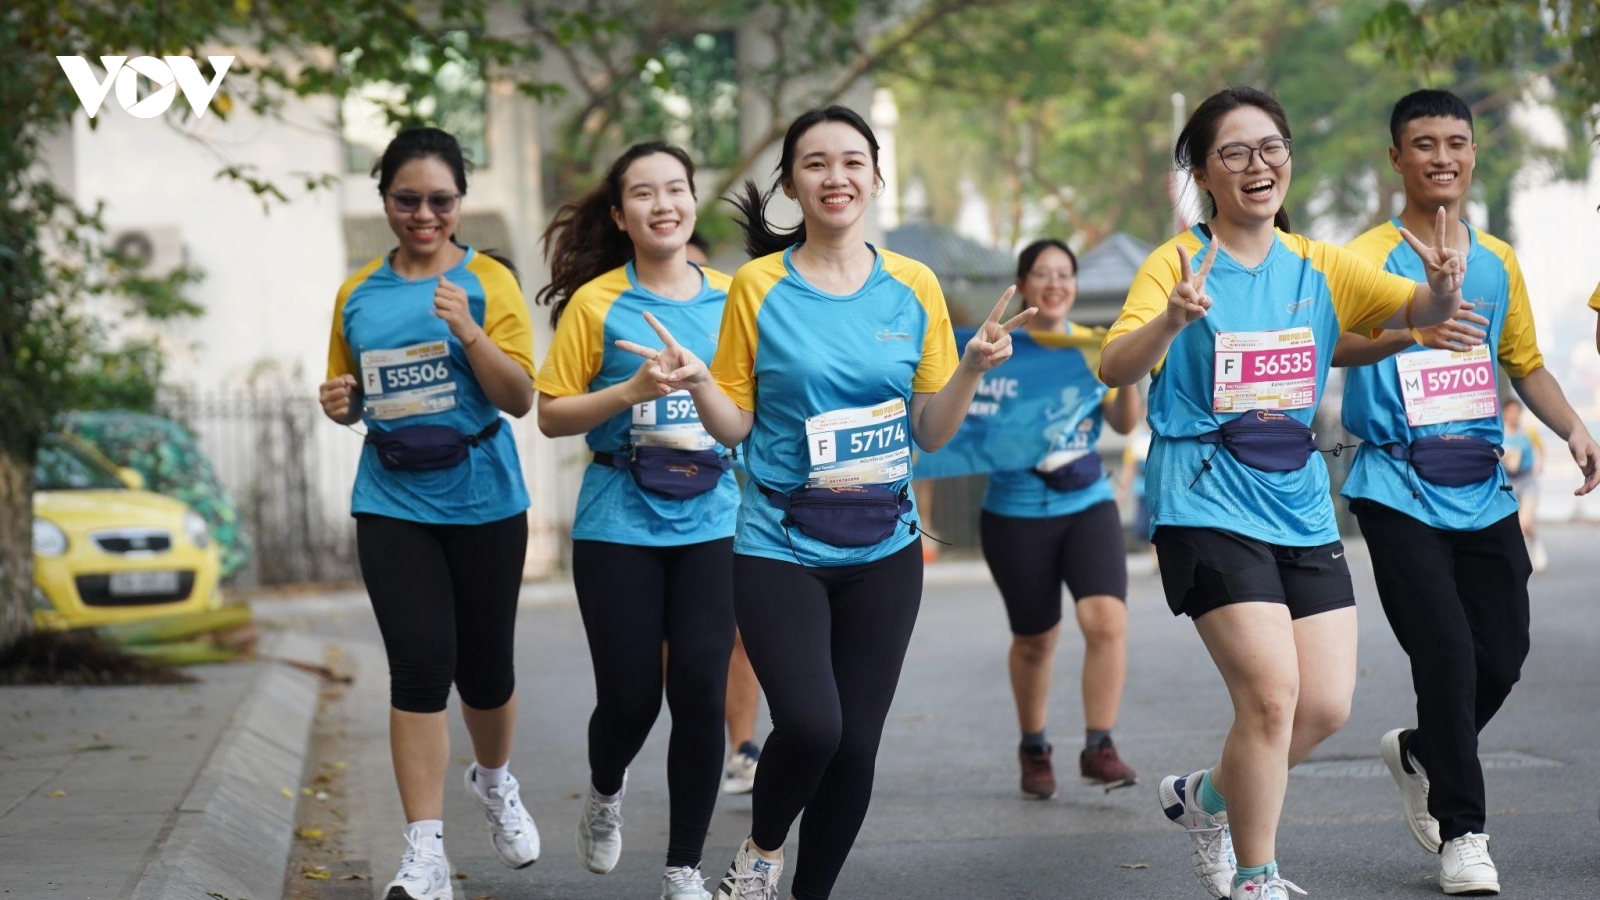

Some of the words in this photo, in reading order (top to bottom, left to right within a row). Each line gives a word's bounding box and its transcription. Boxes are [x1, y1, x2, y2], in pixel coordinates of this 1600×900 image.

[1225, 359, 1234, 374] F
[1254, 351, 1312, 376] 56535
[368, 374, 376, 387] F
[386, 360, 449, 388] 55506
[1427, 366, 1489, 392] 59700
[1405, 377, 1420, 392] M
[640, 404, 649, 417] F
[850, 422, 905, 454] 57174
[818, 440, 828, 456] F
